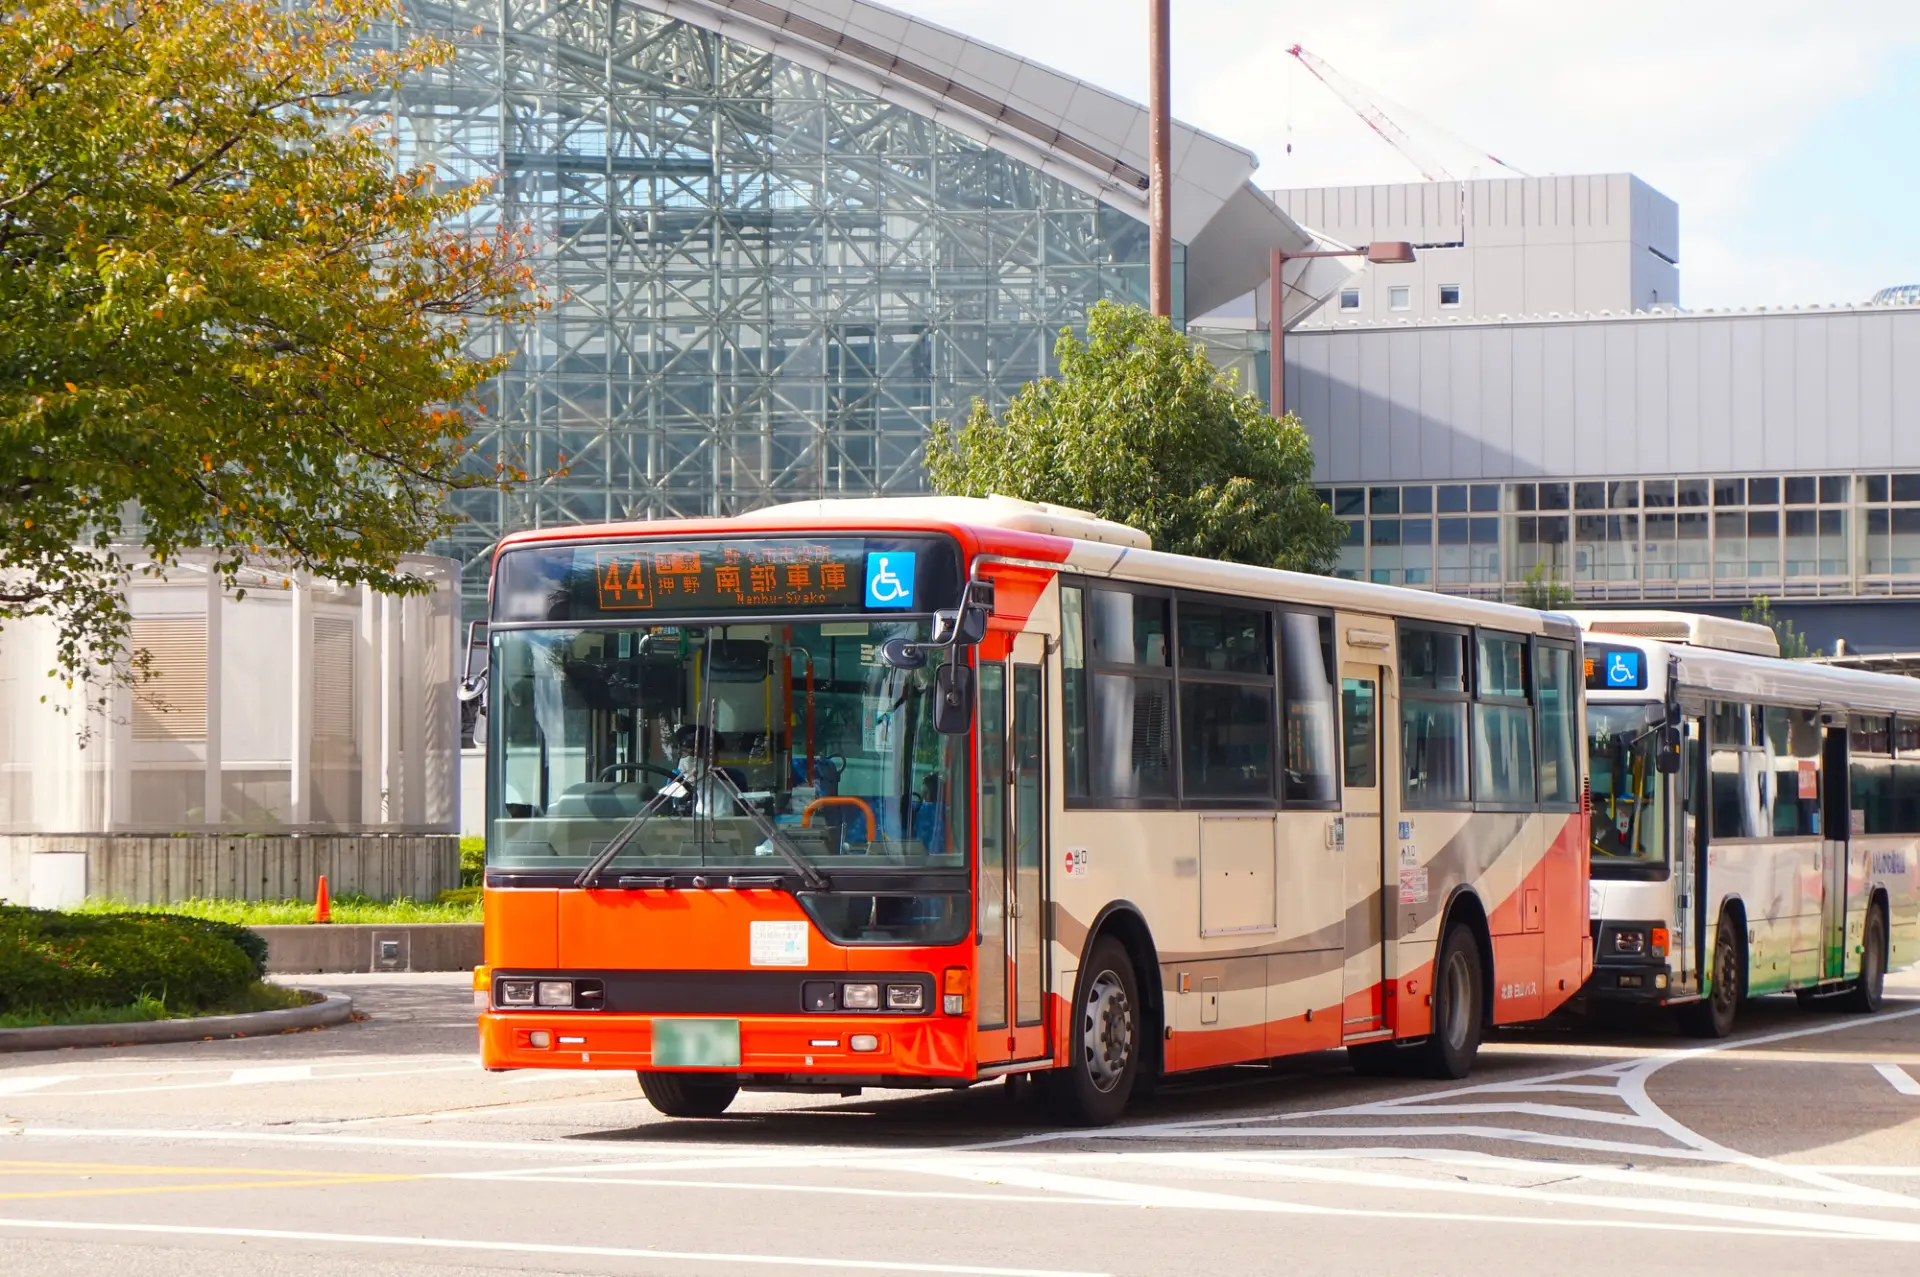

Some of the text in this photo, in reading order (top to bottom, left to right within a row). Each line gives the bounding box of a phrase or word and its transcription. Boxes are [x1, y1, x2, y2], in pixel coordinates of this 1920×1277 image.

[724, 545, 830, 564] 野々市市役所
[604, 558, 645, 600] 44
[658, 576, 700, 595] 押野
[714, 564, 846, 593] 南部車庫
